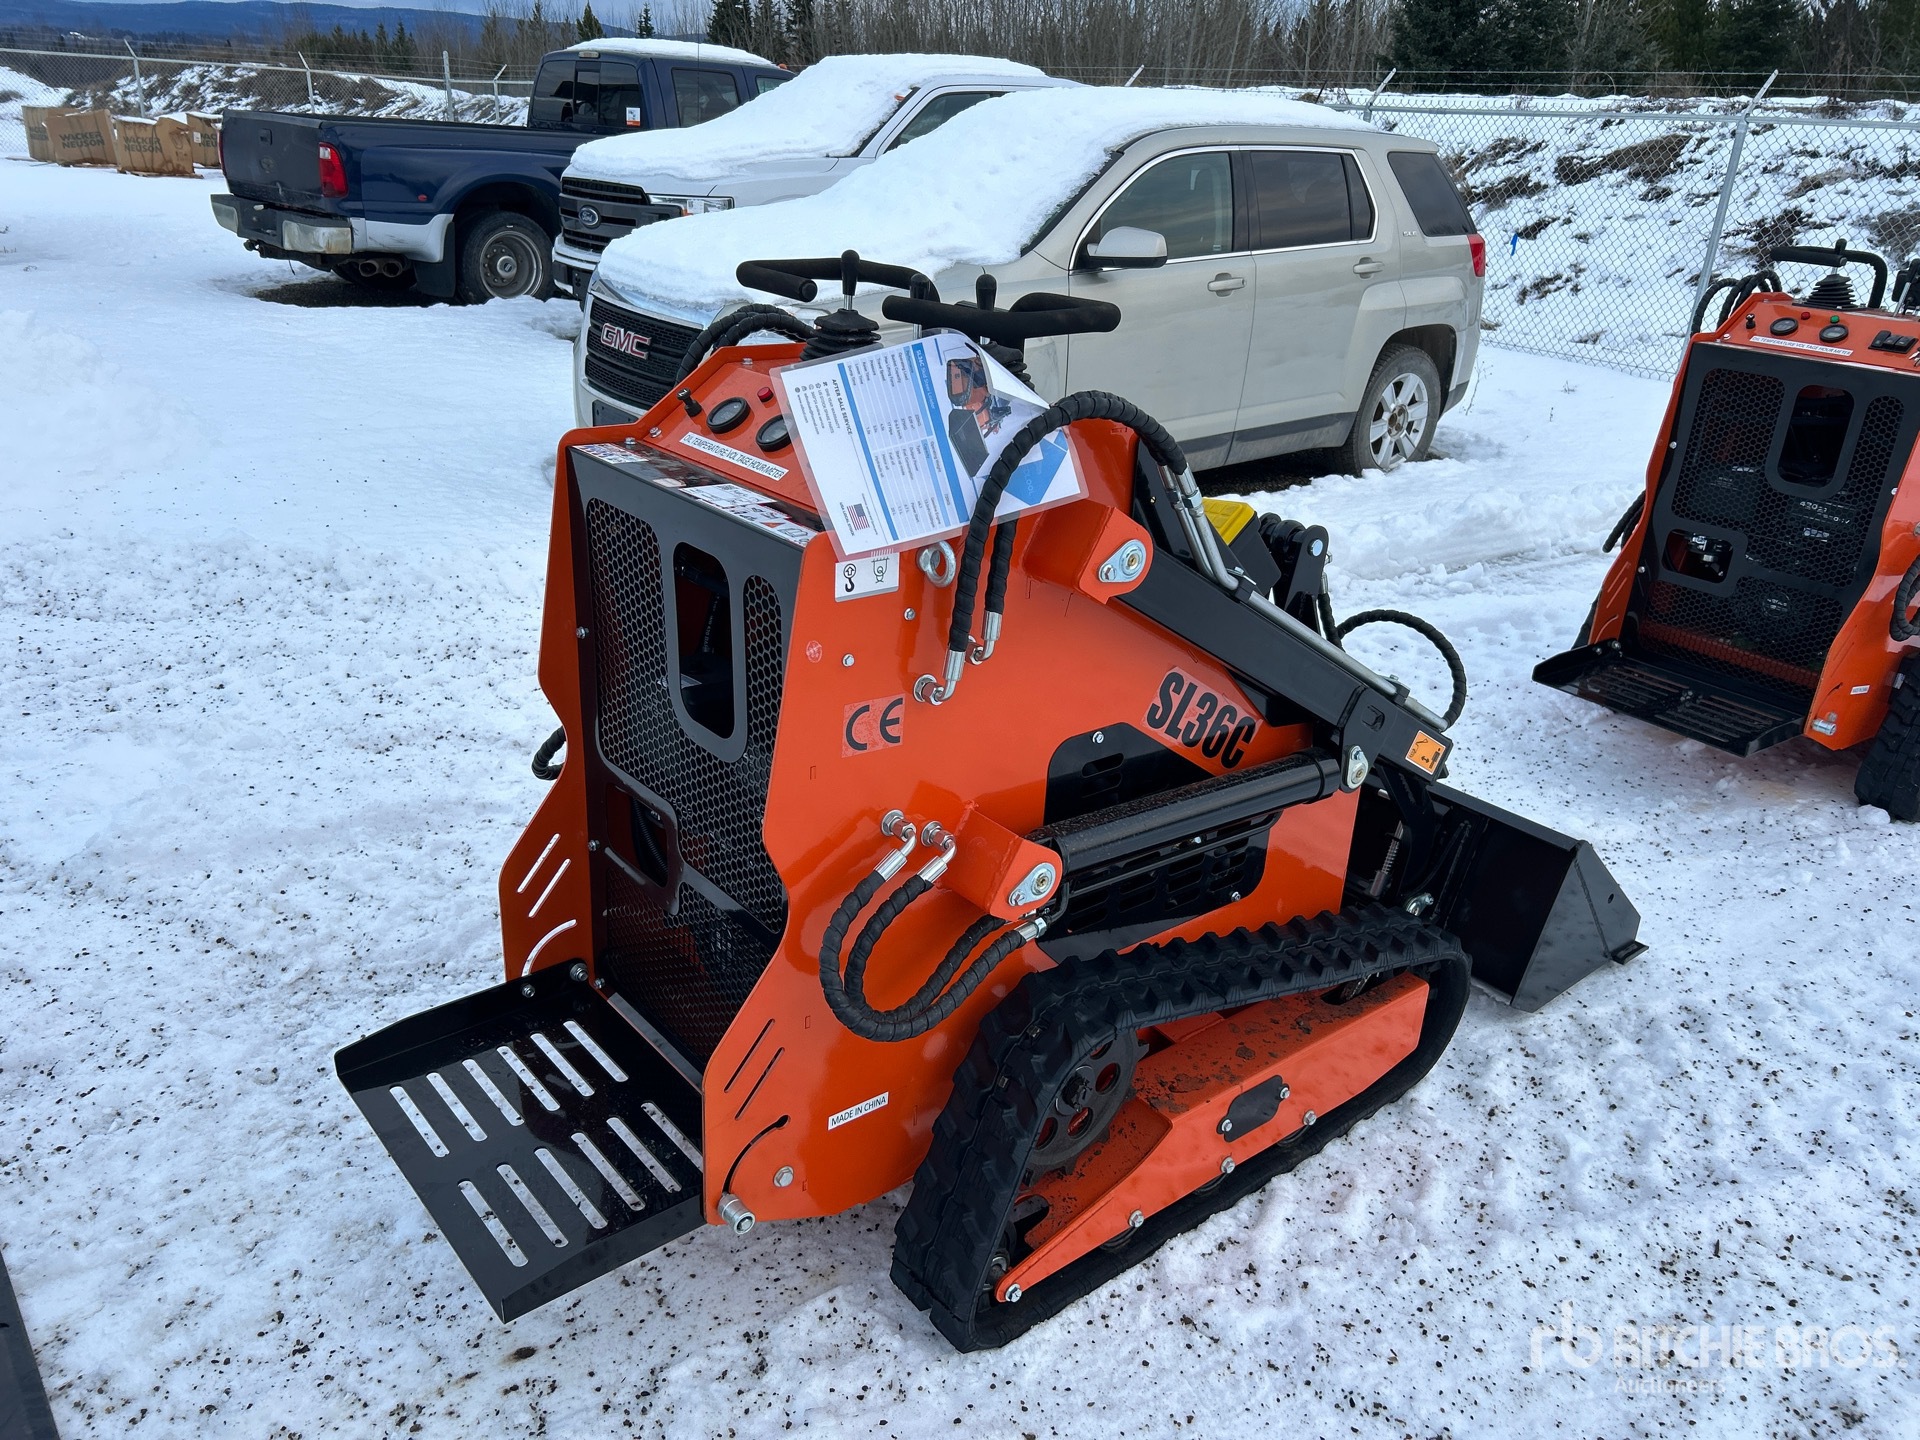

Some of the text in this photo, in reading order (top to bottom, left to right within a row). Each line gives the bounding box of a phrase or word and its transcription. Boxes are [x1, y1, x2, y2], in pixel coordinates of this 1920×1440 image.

[59, 131, 103, 143] WACKER
[62, 138, 105, 149] NEUSON
[123, 136, 161, 147] WACKER
[124, 143, 162, 153] NEUSON
[600, 323, 651, 360] GMC
[1761, 337, 1796, 347] TEMPERATURE
[830, 407, 839, 428] WARRANTY
[832, 378, 852, 435] AFTER SALE SERVICE
[683, 434, 691, 443] OIL
[691, 437, 729, 454] TEMPERATURE
[749, 460, 767, 471] HOUR
[764, 466, 784, 479] METER
[846, 698, 904, 751] CE
[1146, 672, 1256, 769] SL36C
[832, 1096, 886, 1126] MADE IN CHINA
